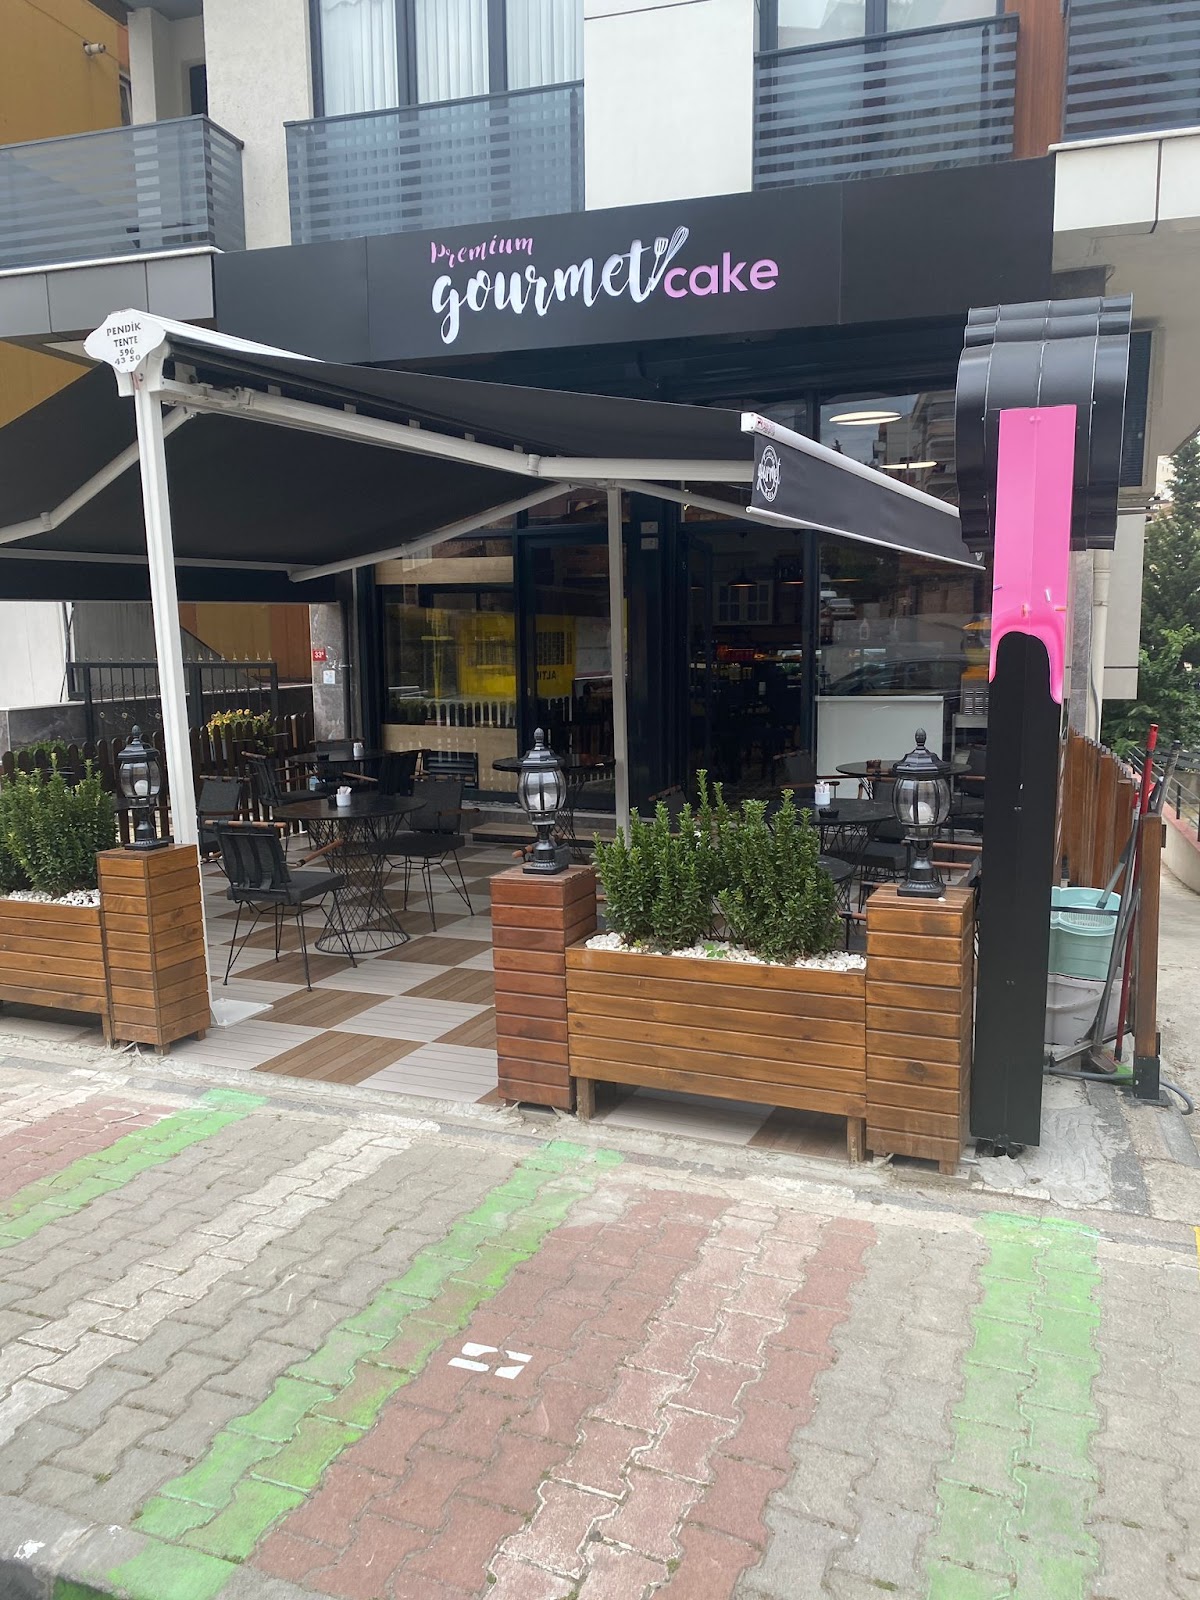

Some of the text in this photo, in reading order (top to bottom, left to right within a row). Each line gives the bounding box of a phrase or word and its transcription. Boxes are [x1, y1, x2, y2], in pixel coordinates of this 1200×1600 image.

[430, 234, 534, 267] Premium
[431, 239, 780, 345] gourmet cake
[106, 321, 142, 336] PENDİK
[113, 336, 138, 347] TENTE
[119, 347, 135, 357] 596
